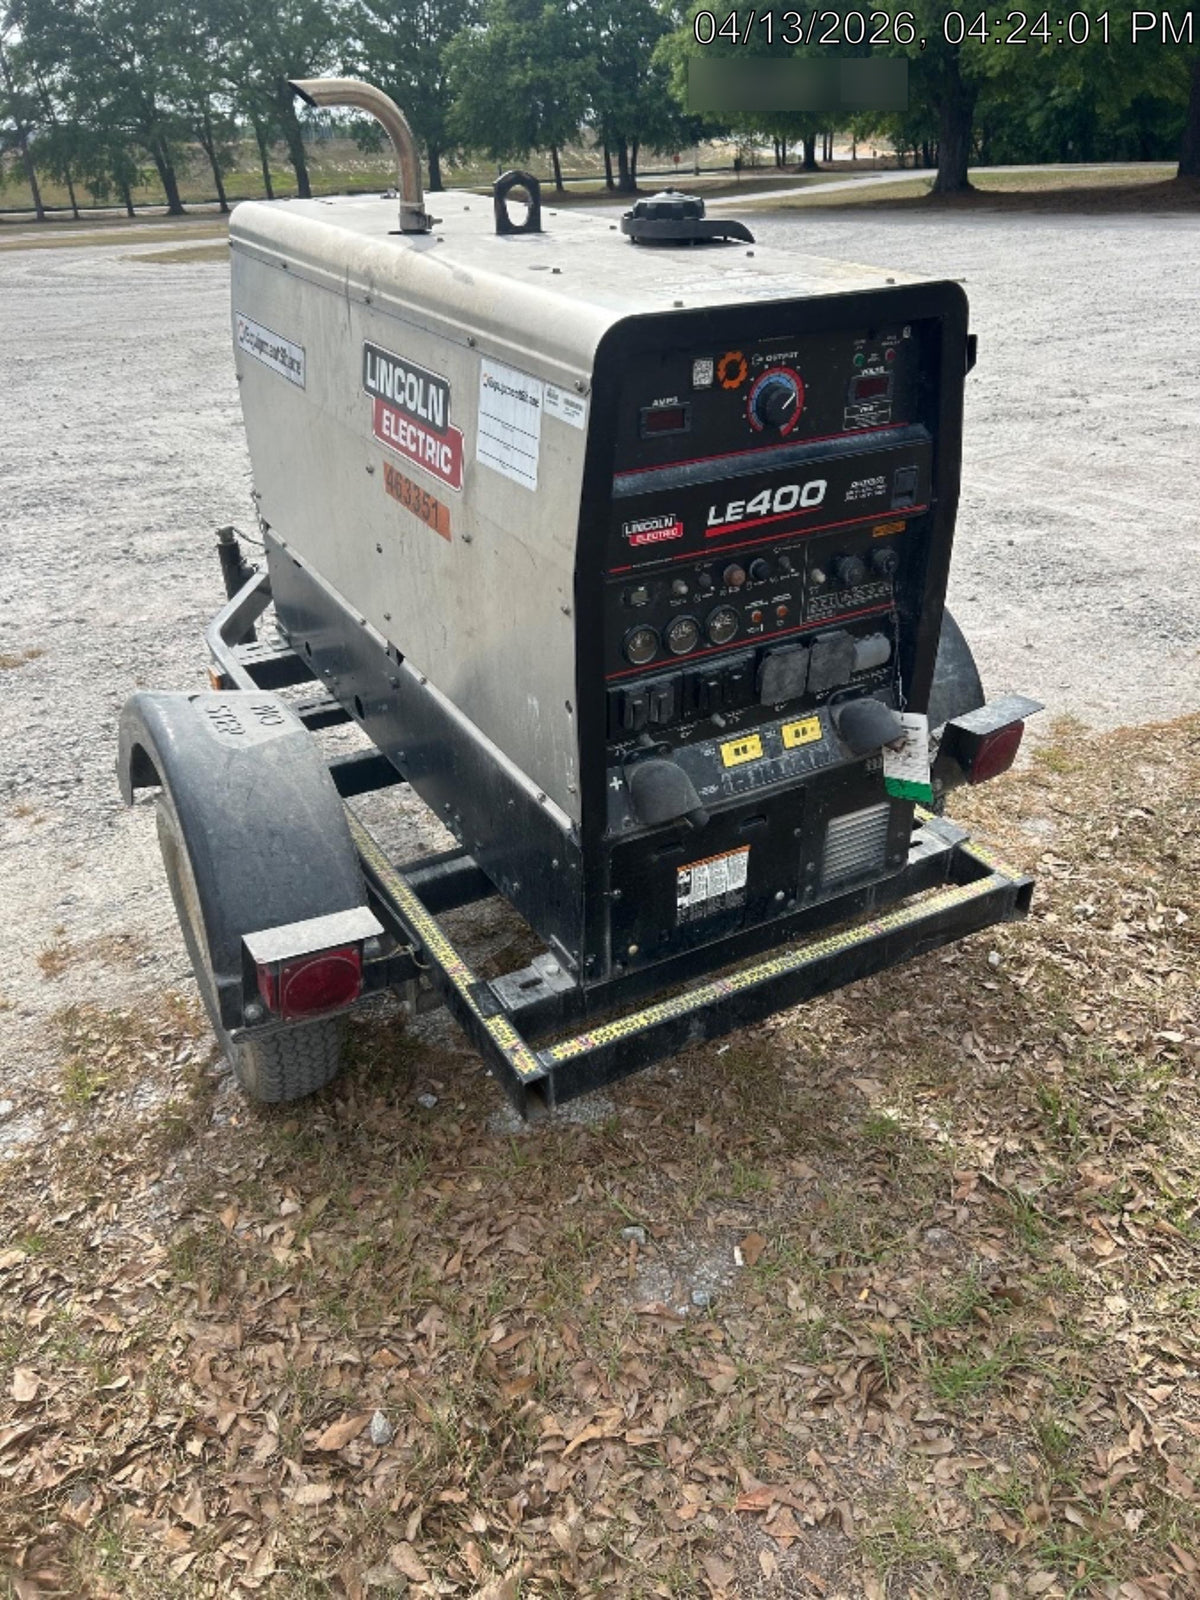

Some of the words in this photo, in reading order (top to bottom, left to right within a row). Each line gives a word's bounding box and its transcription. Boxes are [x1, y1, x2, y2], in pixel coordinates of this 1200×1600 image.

[366, 351, 444, 428] LINCOLN
[382, 408, 453, 475] ELECTRIC
[386, 463, 440, 530] 463351
[707, 479, 828, 527] LE400
[625, 517, 673, 536] LINCOLN
[636, 528, 678, 543] ELECTRIC
[205, 704, 247, 735] STEP
[250, 704, 286, 726] NO
